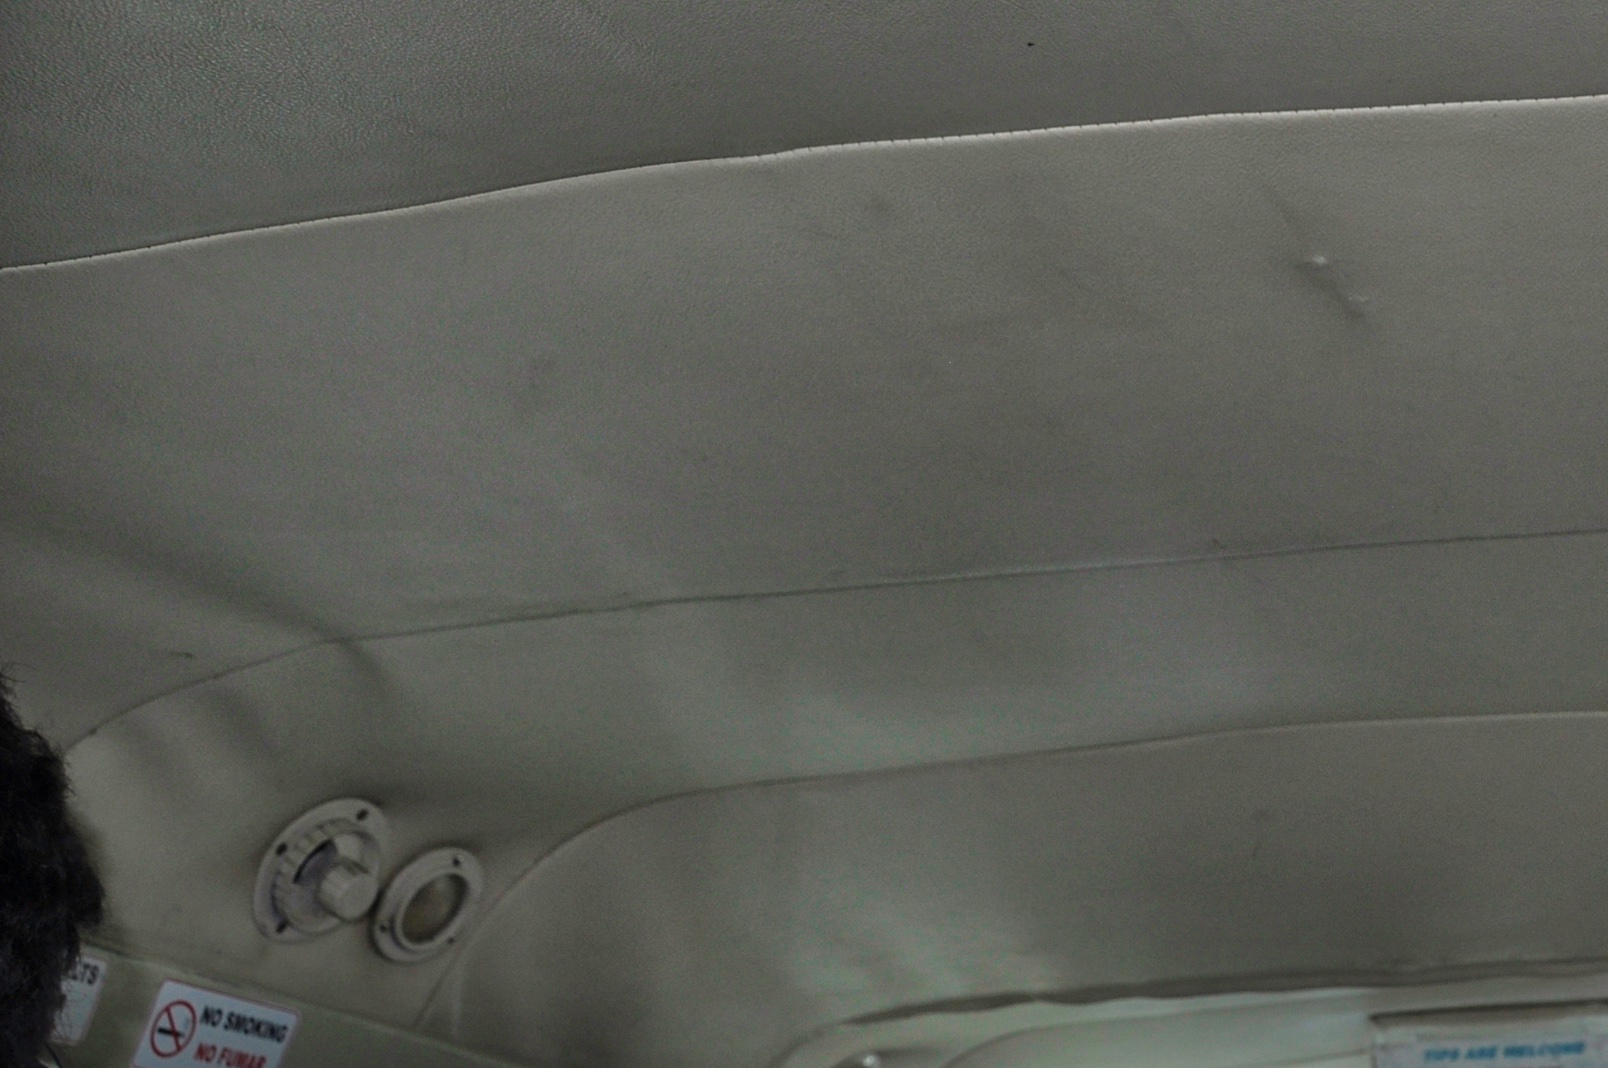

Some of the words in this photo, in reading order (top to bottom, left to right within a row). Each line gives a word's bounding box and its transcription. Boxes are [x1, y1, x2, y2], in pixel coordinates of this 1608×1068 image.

[201, 1006, 222, 1028] NO
[225, 1012, 287, 1043] SMOKING
[194, 1043, 216, 1062] NO
[1426, 1049, 1458, 1062] TIPS
[1467, 1046, 1497, 1059] ARE
[1505, 1043, 1583, 1057] WELCOME
